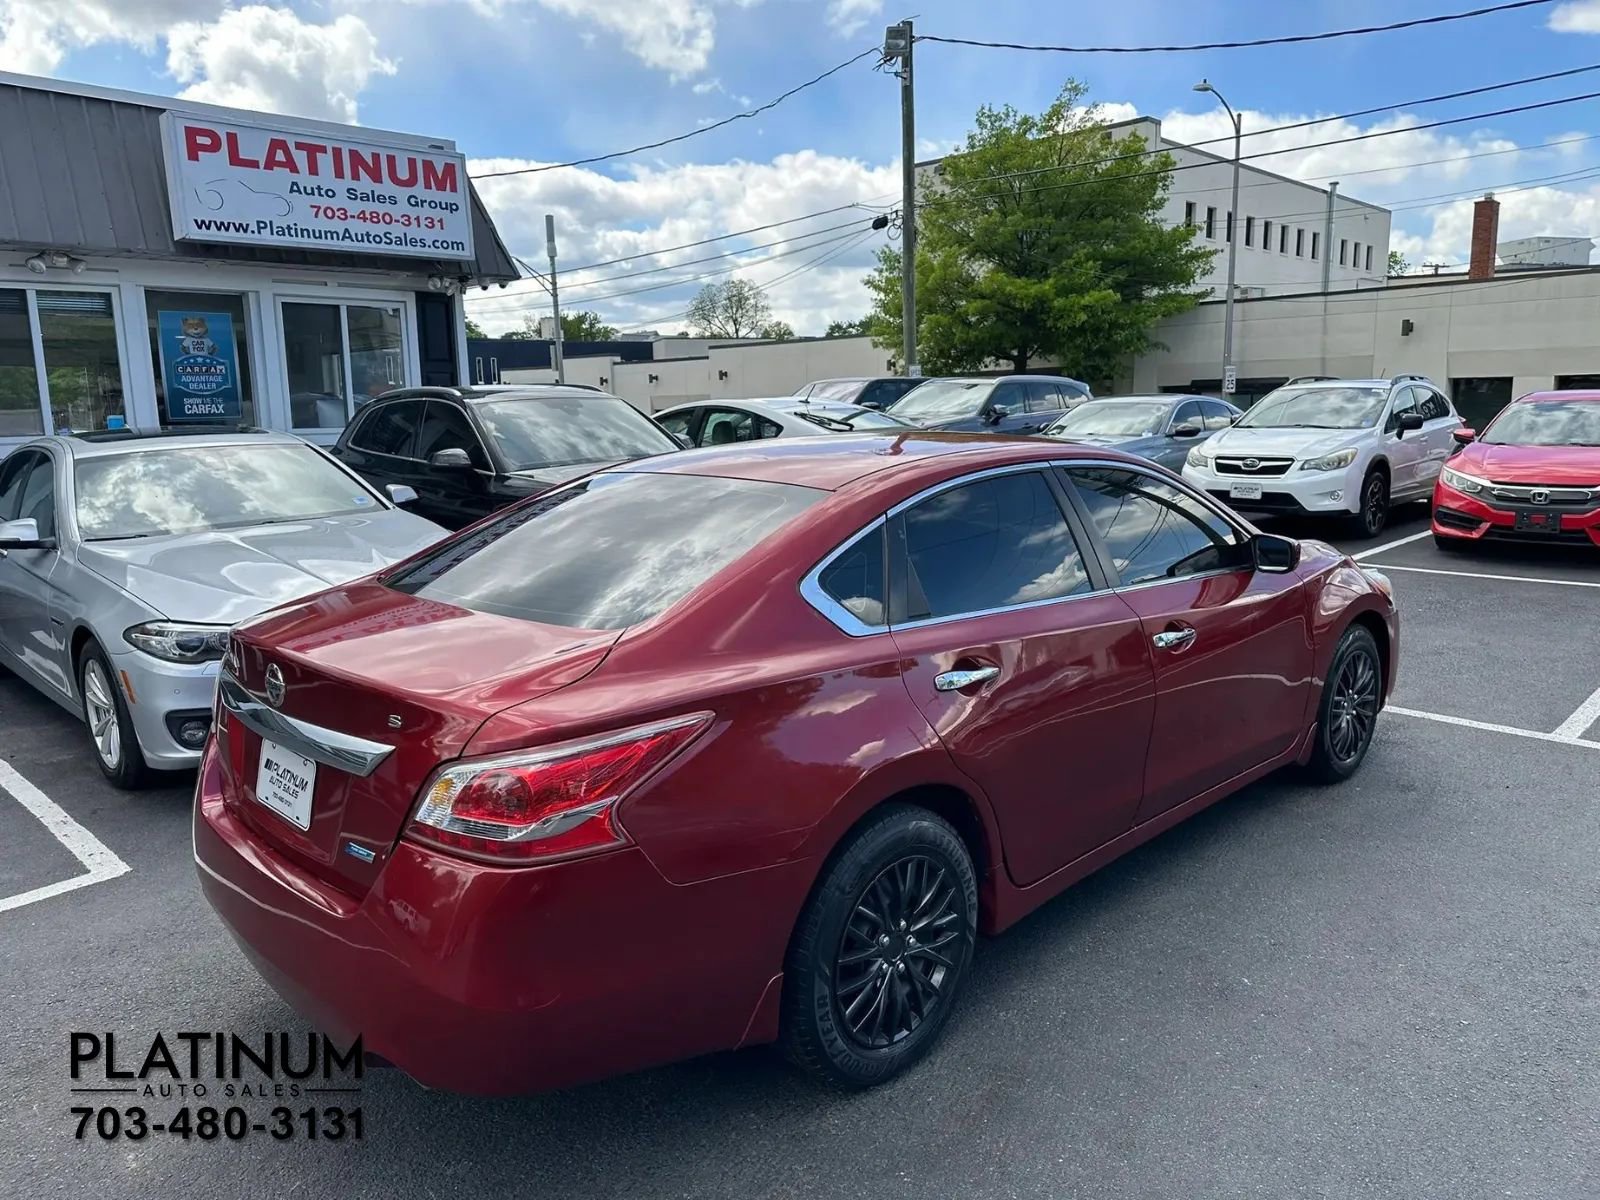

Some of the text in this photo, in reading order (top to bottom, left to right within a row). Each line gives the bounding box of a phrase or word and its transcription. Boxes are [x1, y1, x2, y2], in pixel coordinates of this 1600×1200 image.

[184, 125, 458, 194] PLATINUM
[289, 181, 460, 214] Auto Sales Group
[310, 204, 445, 230] 703-480-3131
[193, 218, 465, 252] www.PlatinumAutoSales.com
[177, 366, 225, 374] CARFAX
[1227, 379, 1235, 390] 25
[184, 404, 225, 414] CARFAX
[388, 715, 402, 728] S
[269, 775, 283, 789] AUTO
[282, 783, 300, 800] SALES
[272, 762, 309, 792] PLATINUM
